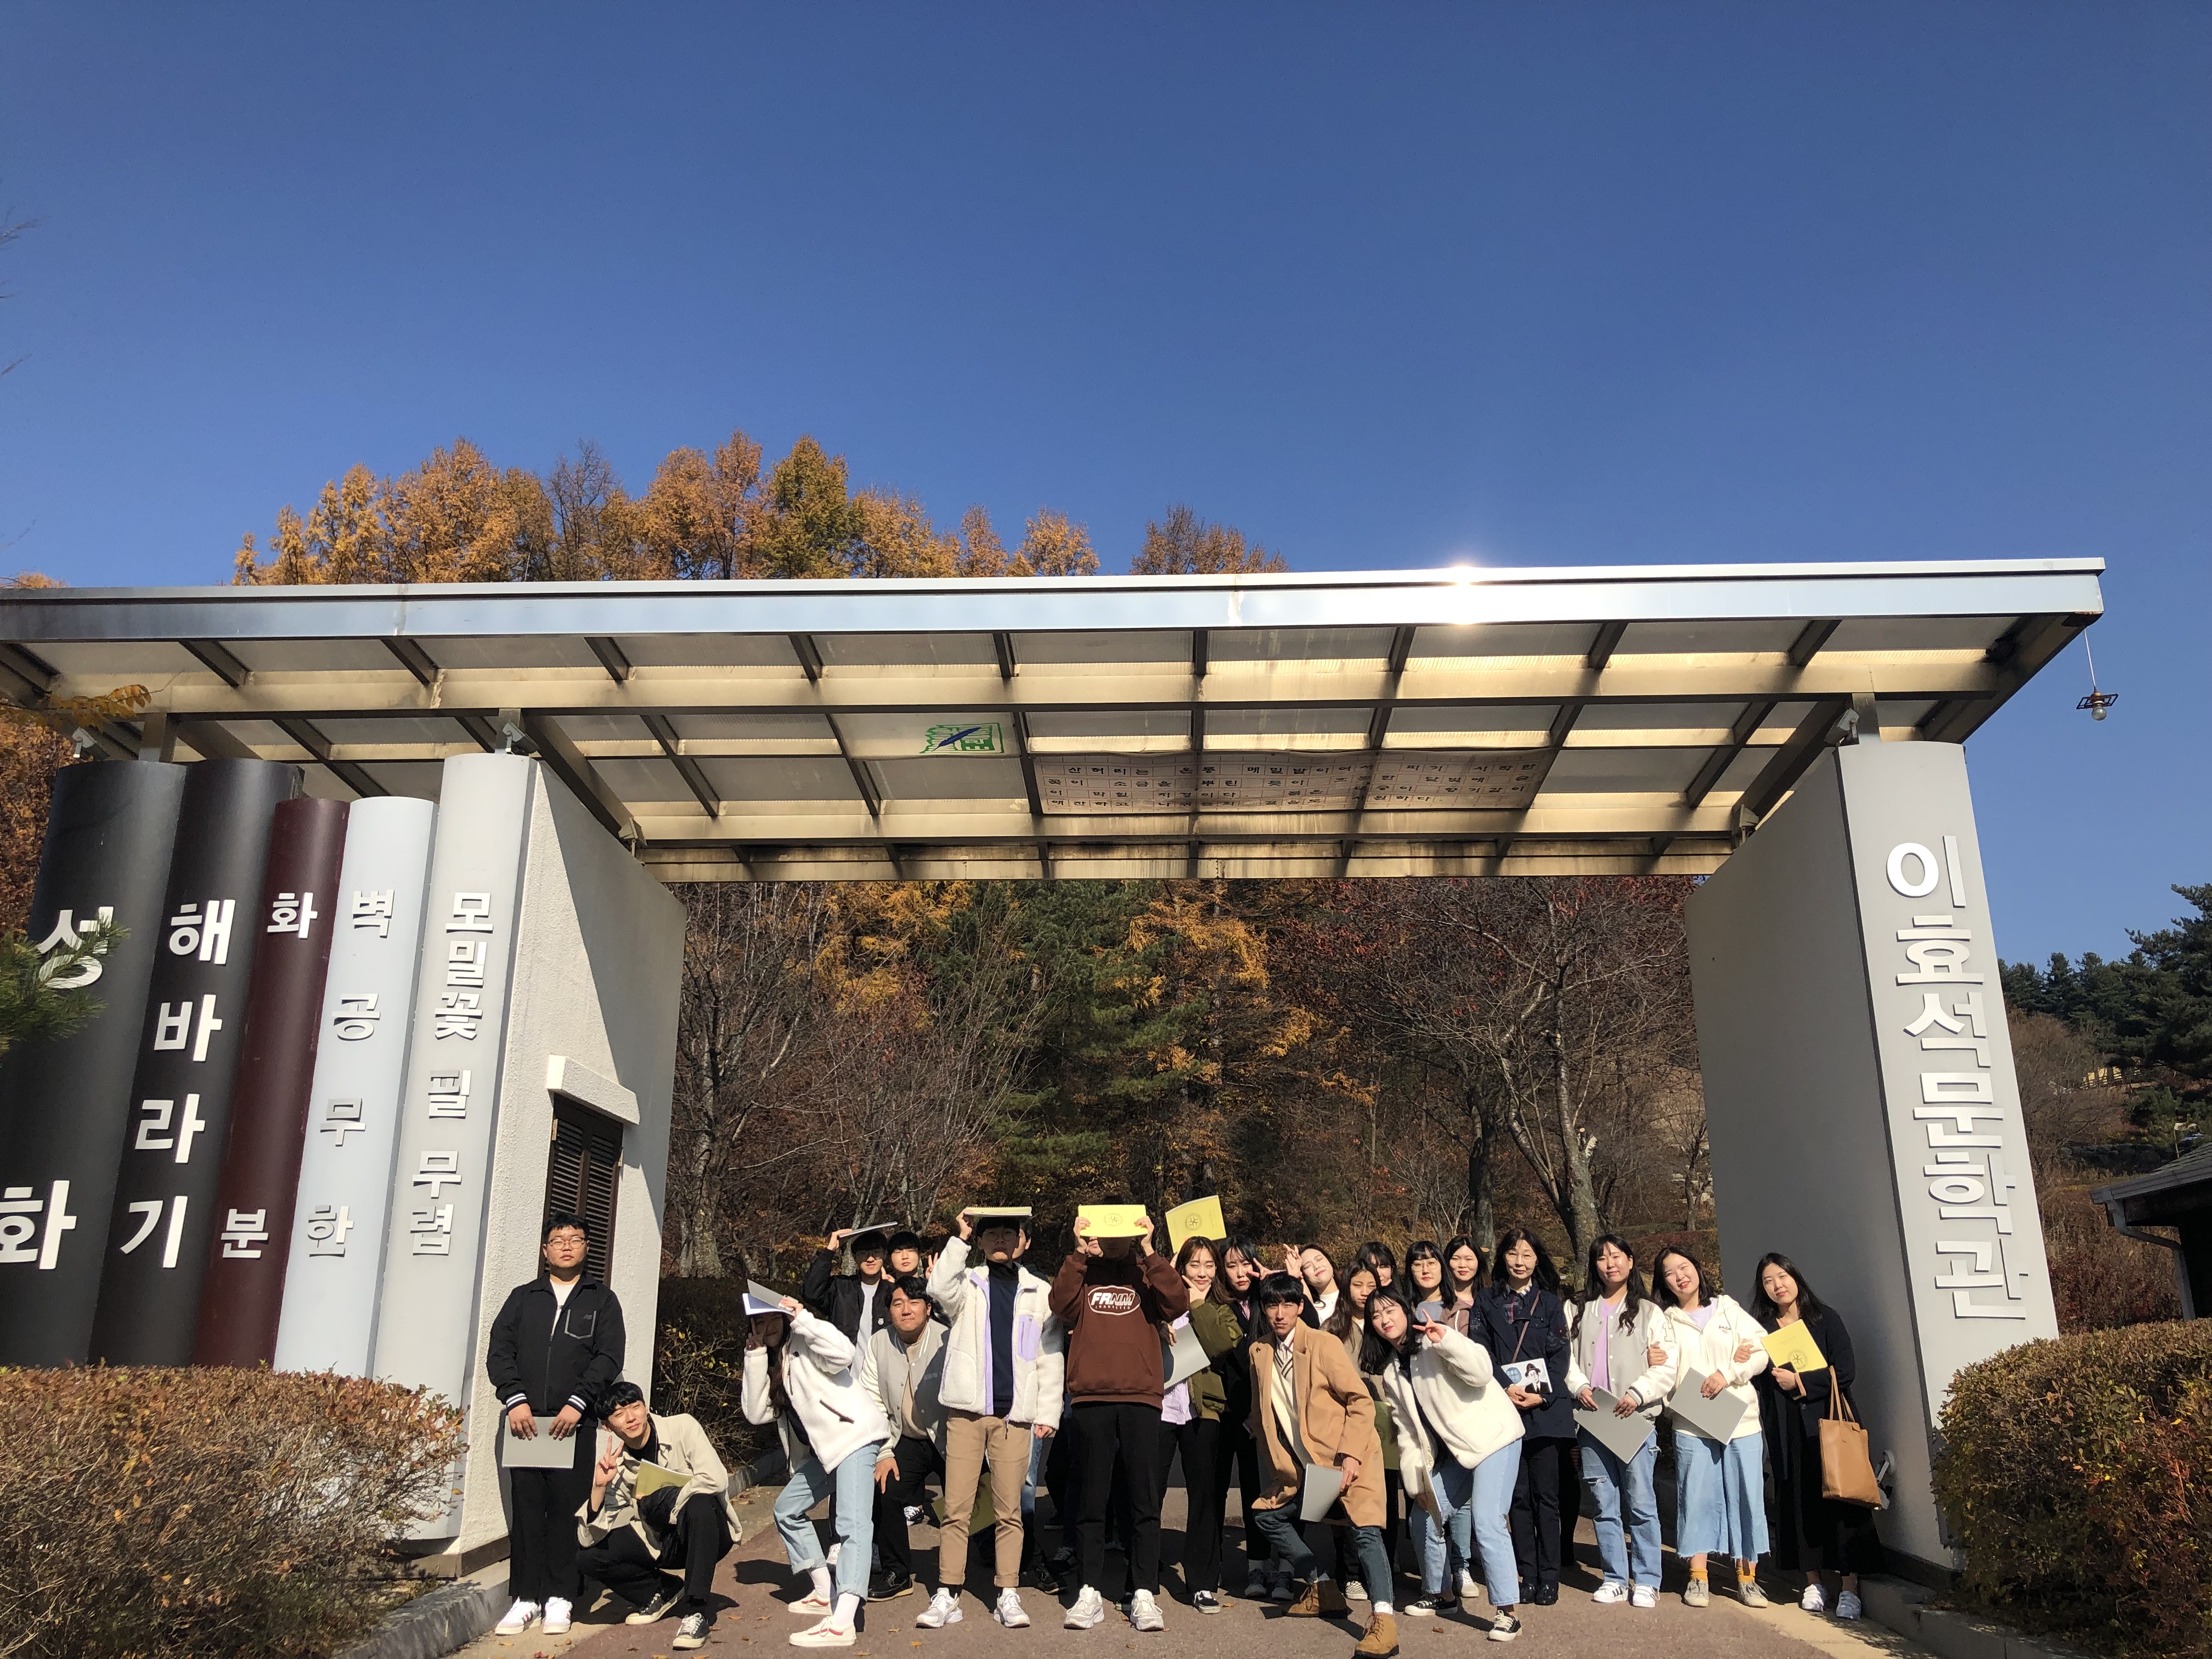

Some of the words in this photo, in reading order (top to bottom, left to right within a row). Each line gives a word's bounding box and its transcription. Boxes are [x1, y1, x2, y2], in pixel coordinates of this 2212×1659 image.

[1068, 767, 1149, 775] 산허리는
[1247, 764, 1373, 775] 메밀밭이어서
[1474, 764, 1536, 772] 시작한
[435, 891, 493, 1040] 모밀꽃
[120, 898, 236, 1268] 해바라기
[428, 1070, 472, 1119] 필
[1886, 835, 2029, 1319] 이효석문학관
[410, 1150, 462, 1256] 무렵
[1091, 1293, 1135, 1306] FRNM
